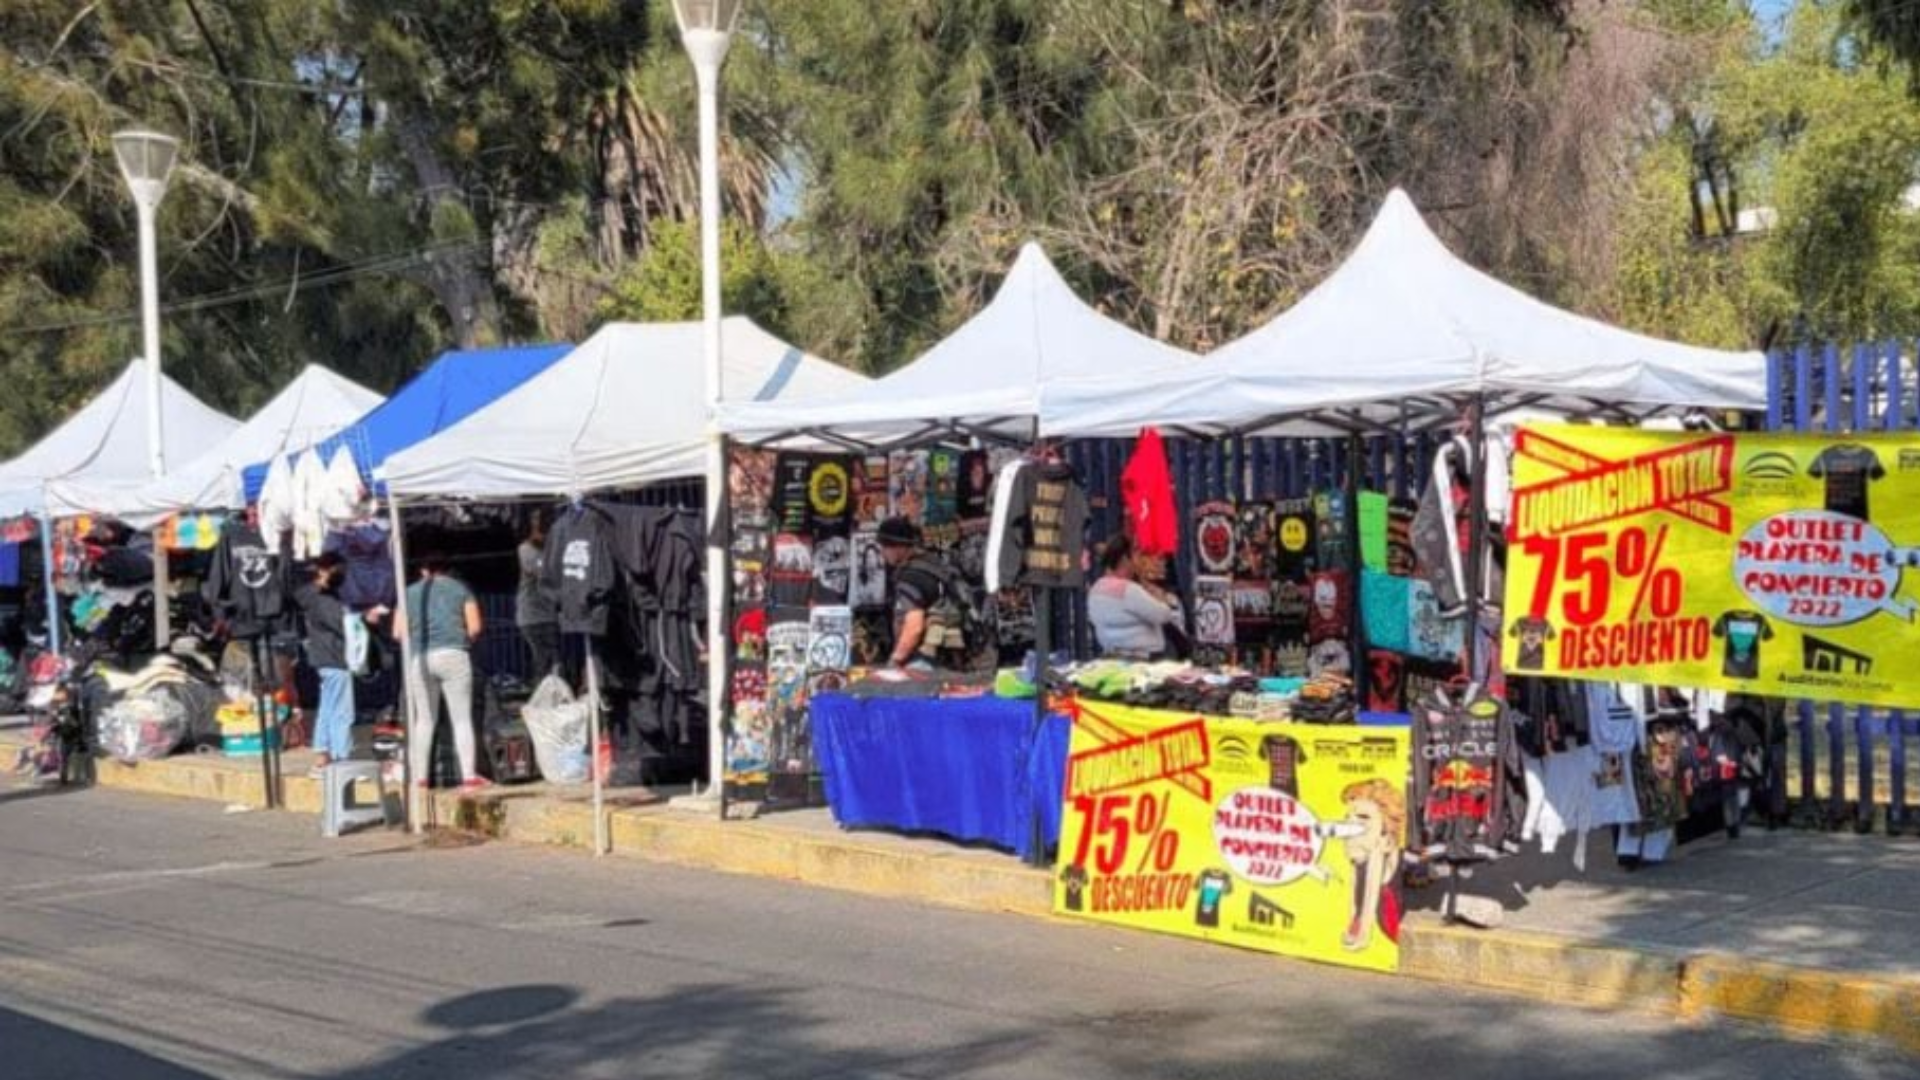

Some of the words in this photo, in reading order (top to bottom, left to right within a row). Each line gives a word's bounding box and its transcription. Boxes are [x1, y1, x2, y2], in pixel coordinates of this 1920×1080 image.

[1766, 517, 1863, 542] OUTLET
[1737, 540, 1842, 564] PLAYERA
[1851, 551, 1882, 575] DE
[1523, 523, 1682, 626] 75%
[1744, 571, 1887, 600] CONCIERTO
[1787, 599, 1842, 617] 2022
[1558, 615, 1711, 671] DESCUENTO
[1422, 741, 1500, 760] ORCLE
[1233, 792, 1296, 816] OUTLET
[1073, 790, 1180, 875] 75%
[1091, 872, 1194, 914] DESCUENTO
